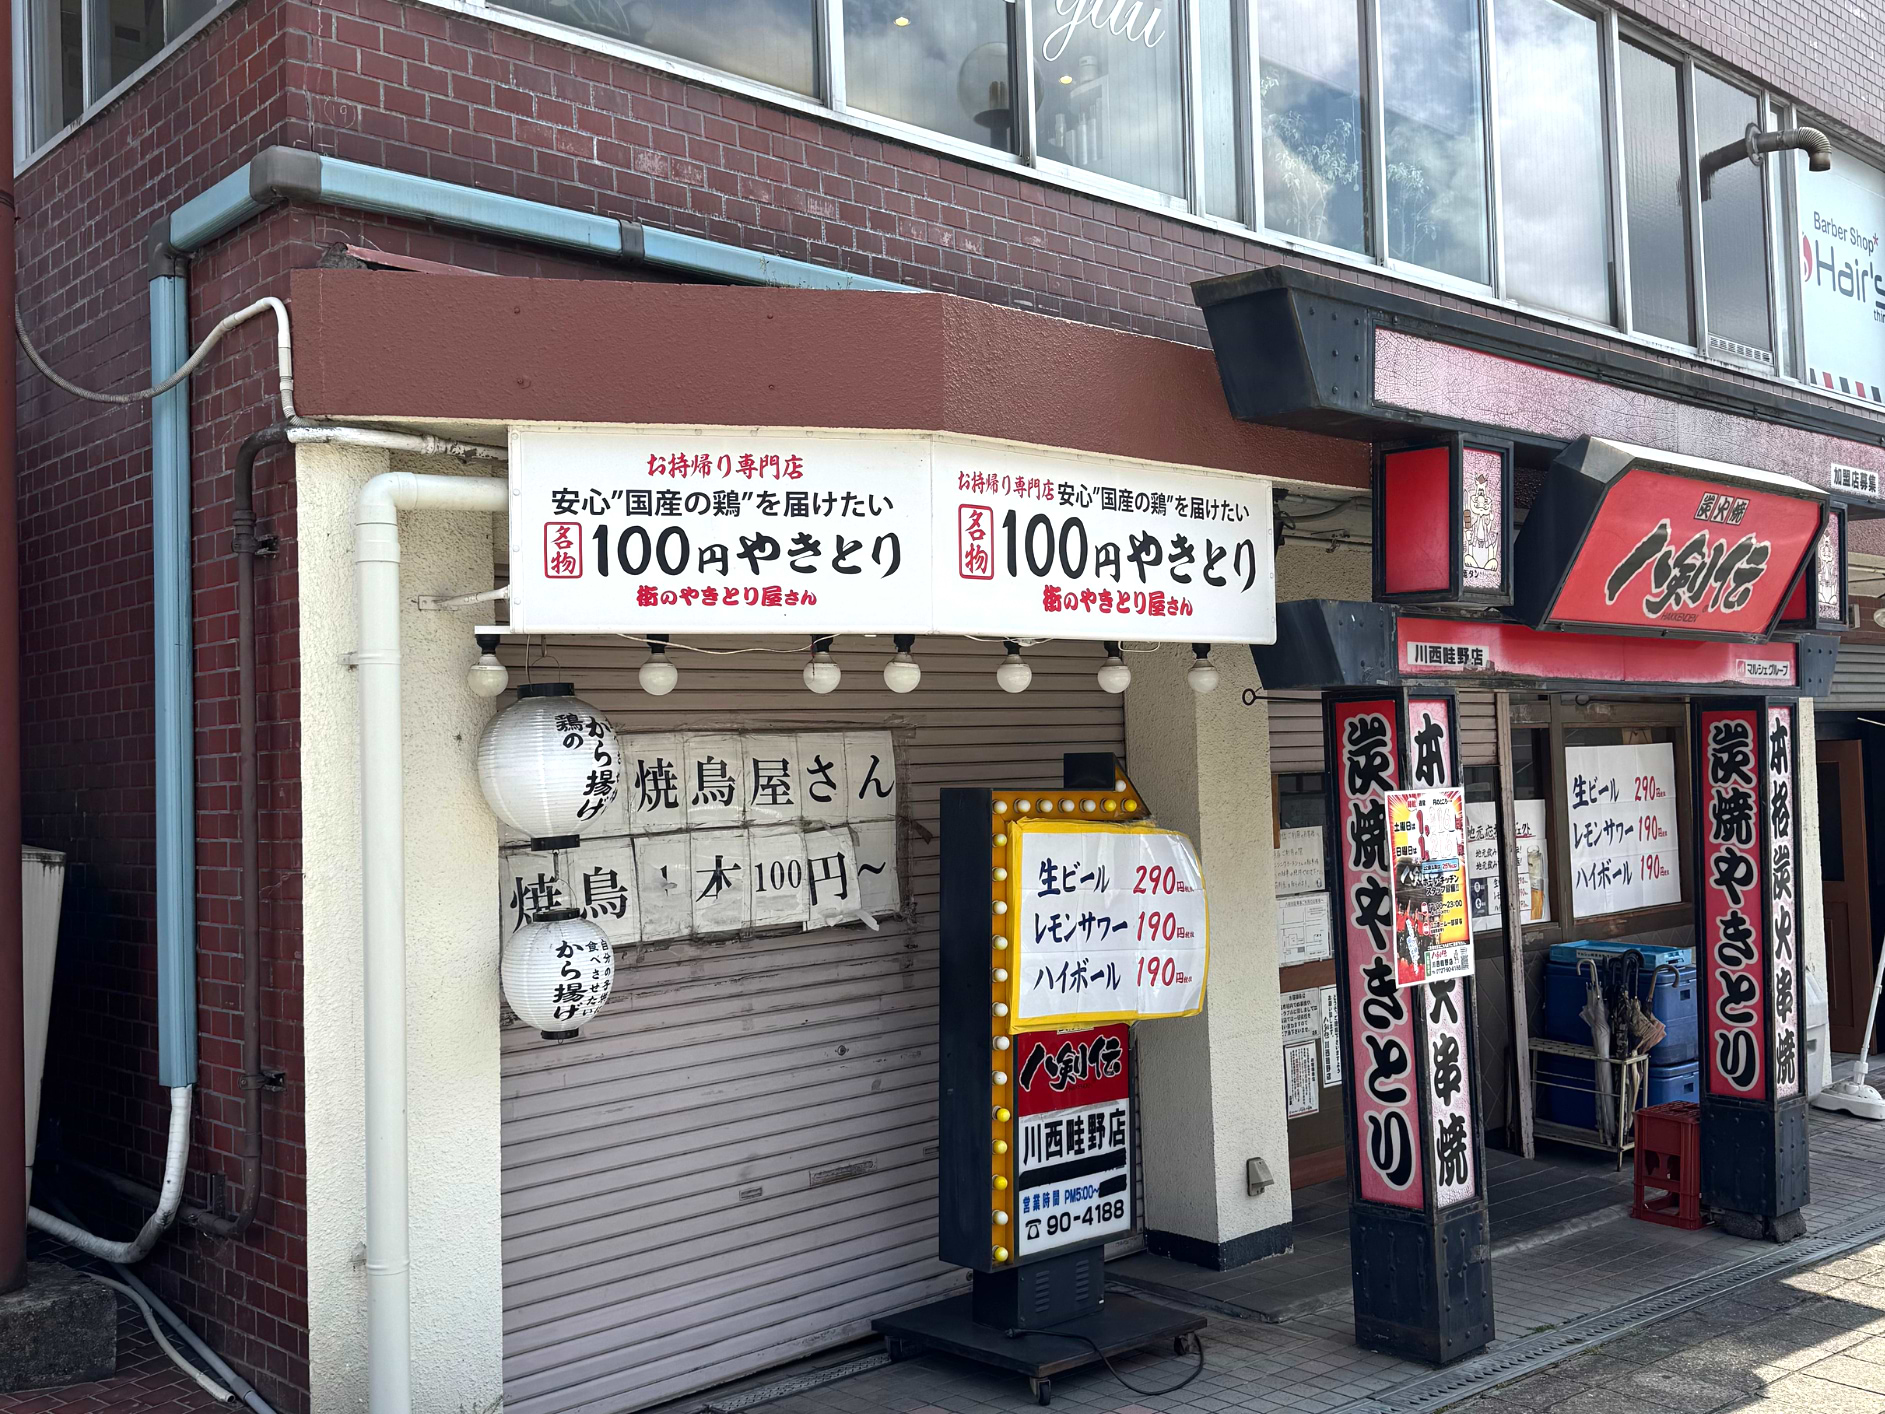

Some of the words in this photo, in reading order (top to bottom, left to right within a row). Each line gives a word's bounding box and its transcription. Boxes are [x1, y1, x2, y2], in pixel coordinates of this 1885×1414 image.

[1813, 210, 1848, 242] Barber
[1849, 226, 1875, 257] Shop
[646, 453, 805, 480] お持帰り専門店
[957, 470, 1055, 501] お持帰り専門店
[1695, 493, 1749, 525] 炭火焼
[550, 525, 577, 575] 名物
[592, 524, 902, 579] 100円やきとり
[964, 509, 989, 575] 名物
[1002, 509, 1257, 594] 100円やきとり
[1604, 518, 1772, 618] 八剣伝
[636, 585, 818, 608] 街のやきとり屋さん
[1042, 584, 1194, 617] 街のやきとり屋さん
[1415, 644, 1483, 666] 川西畦野店
[1747, 663, 1789, 676] マルシェグループ
[554, 712, 584, 750] 鶏の
[576, 716, 616, 822] から揚げ
[634, 754, 895, 813] 焼鳥屋さん
[1572, 774, 1620, 810] 生ビール
[1573, 818, 1634, 849] レモンサワー
[1038, 857, 1110, 898] 生ビール
[1576, 858, 1633, 891] ハイボール
[1711, 722, 1757, 1088] 炭焼やきとり
[1769, 716, 1796, 1085] 本格炭火串焼
[1034, 911, 1128, 944] レモンサワー
[1347, 716, 1412, 1187] 炭焼やきとり
[552, 940, 588, 1022] から揚げ
[1033, 957, 1121, 993] ハイボール
[1019, 1034, 1123, 1092] 八剣伝
[1023, 1108, 1126, 1166] 川西畦野店
[1022, 1189, 1060, 1214] 営業時間
[1046, 1199, 1125, 1236] 90-4188
